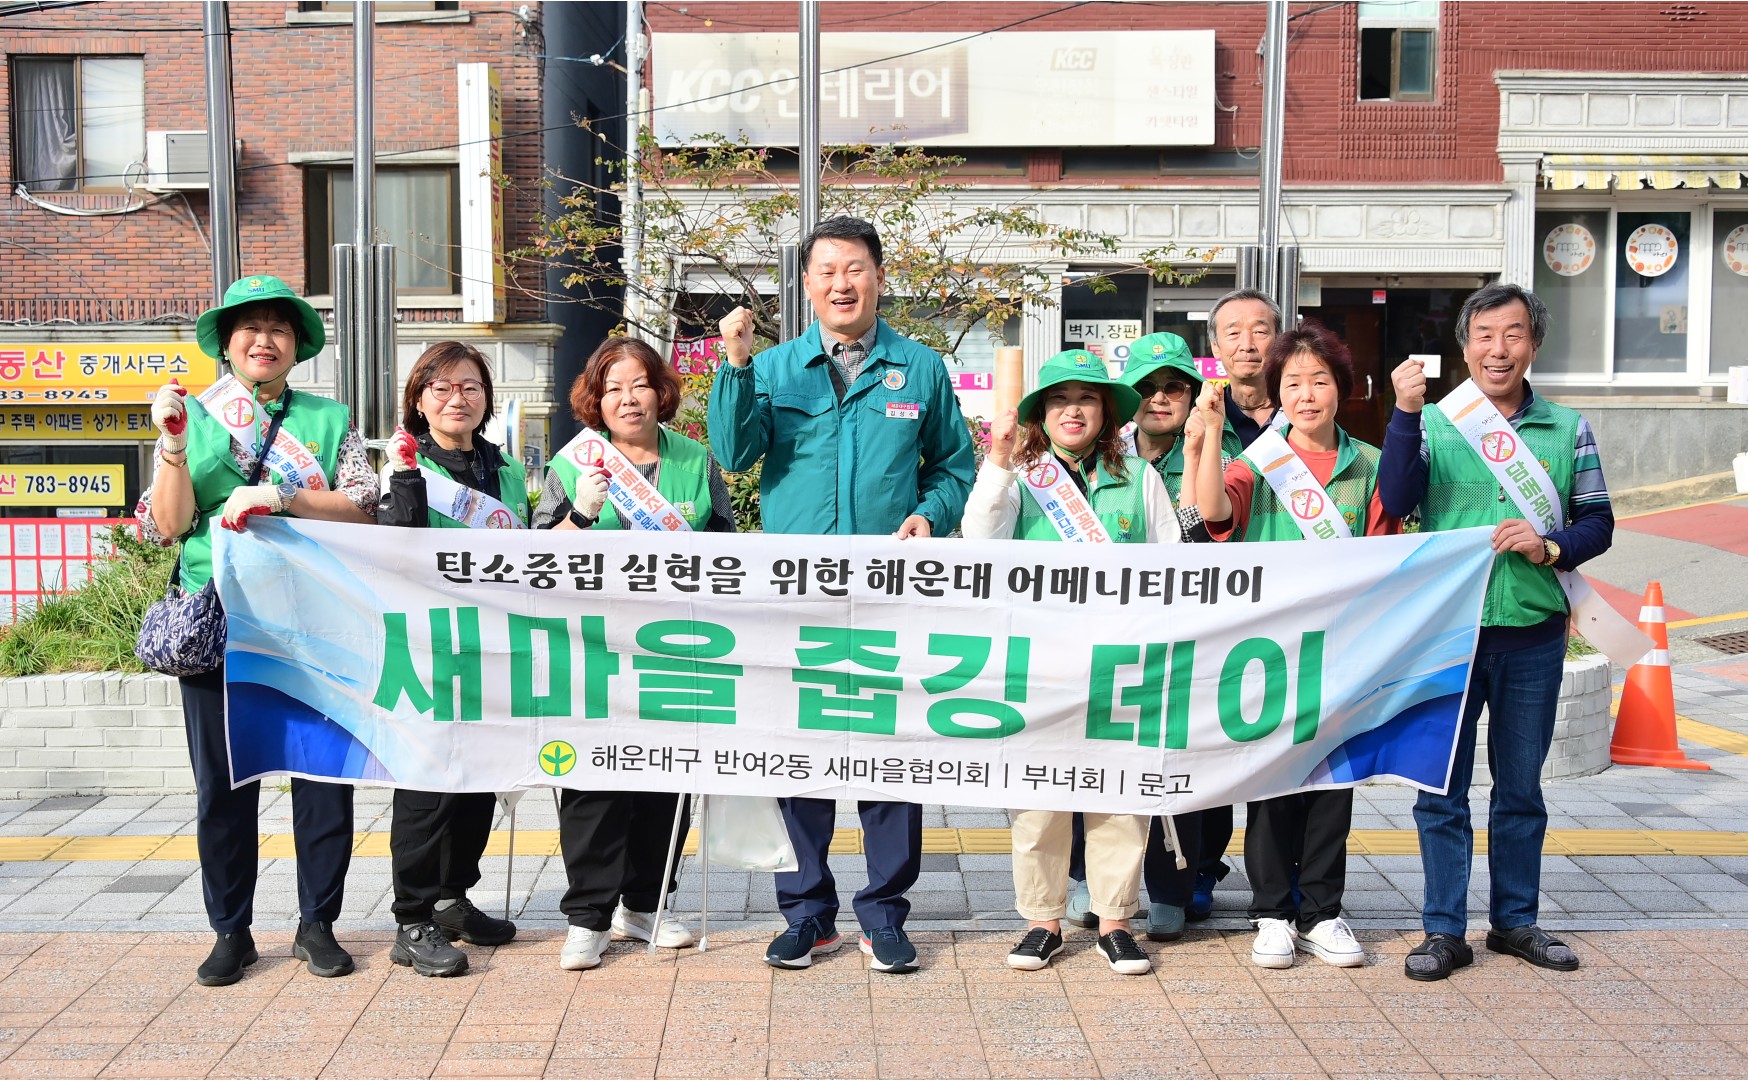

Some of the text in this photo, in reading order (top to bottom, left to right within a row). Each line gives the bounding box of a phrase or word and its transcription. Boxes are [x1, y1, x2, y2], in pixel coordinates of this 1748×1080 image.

[1056, 49, 1094, 70] KCC
[79, 355, 188, 375] 중개사무소
[11, 413, 35, 431] 주택
[45, 413, 83, 431] 아파트
[93, 413, 118, 431] 상가
[127, 413, 152, 431] 토지
[25, 475, 110, 493] 783-8945
[606, 455, 664, 514] 담배꽁초
[436, 552, 1263, 605] 탄소중립 실현을 위한 해운대 어메니티데이
[374, 607, 1326, 750] 새마을 줍깅 데이
[591, 745, 1194, 798] 해운대구 반여2동 새마을협의회 부녀회 문고
